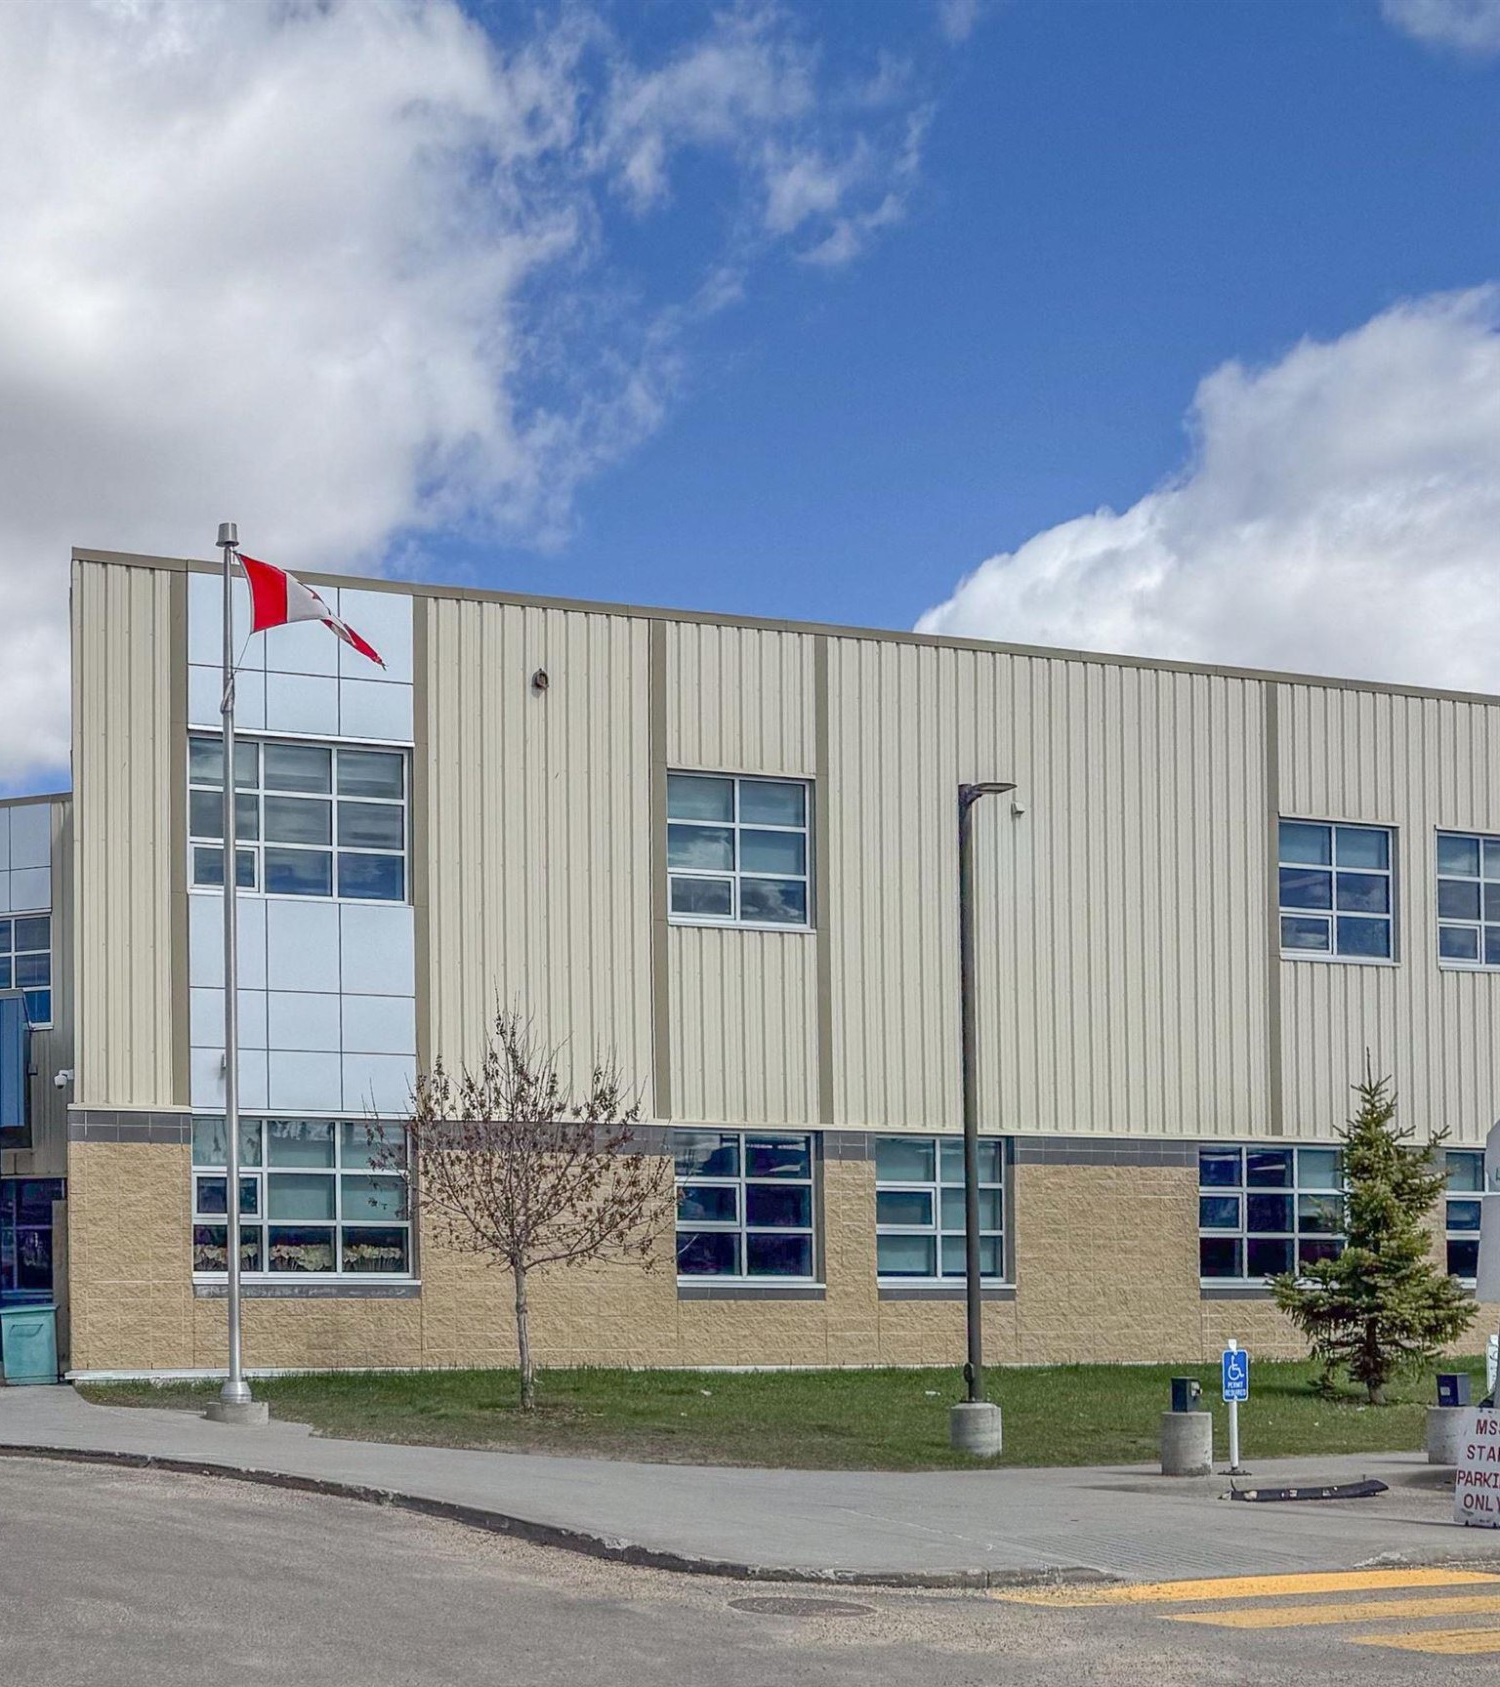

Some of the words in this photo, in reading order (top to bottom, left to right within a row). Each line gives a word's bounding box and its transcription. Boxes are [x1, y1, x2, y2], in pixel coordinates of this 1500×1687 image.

[1475, 1418, 1500, 1436] MS
[1466, 1444, 1500, 1462] STA
[1457, 1470, 1500, 1488] PARKI
